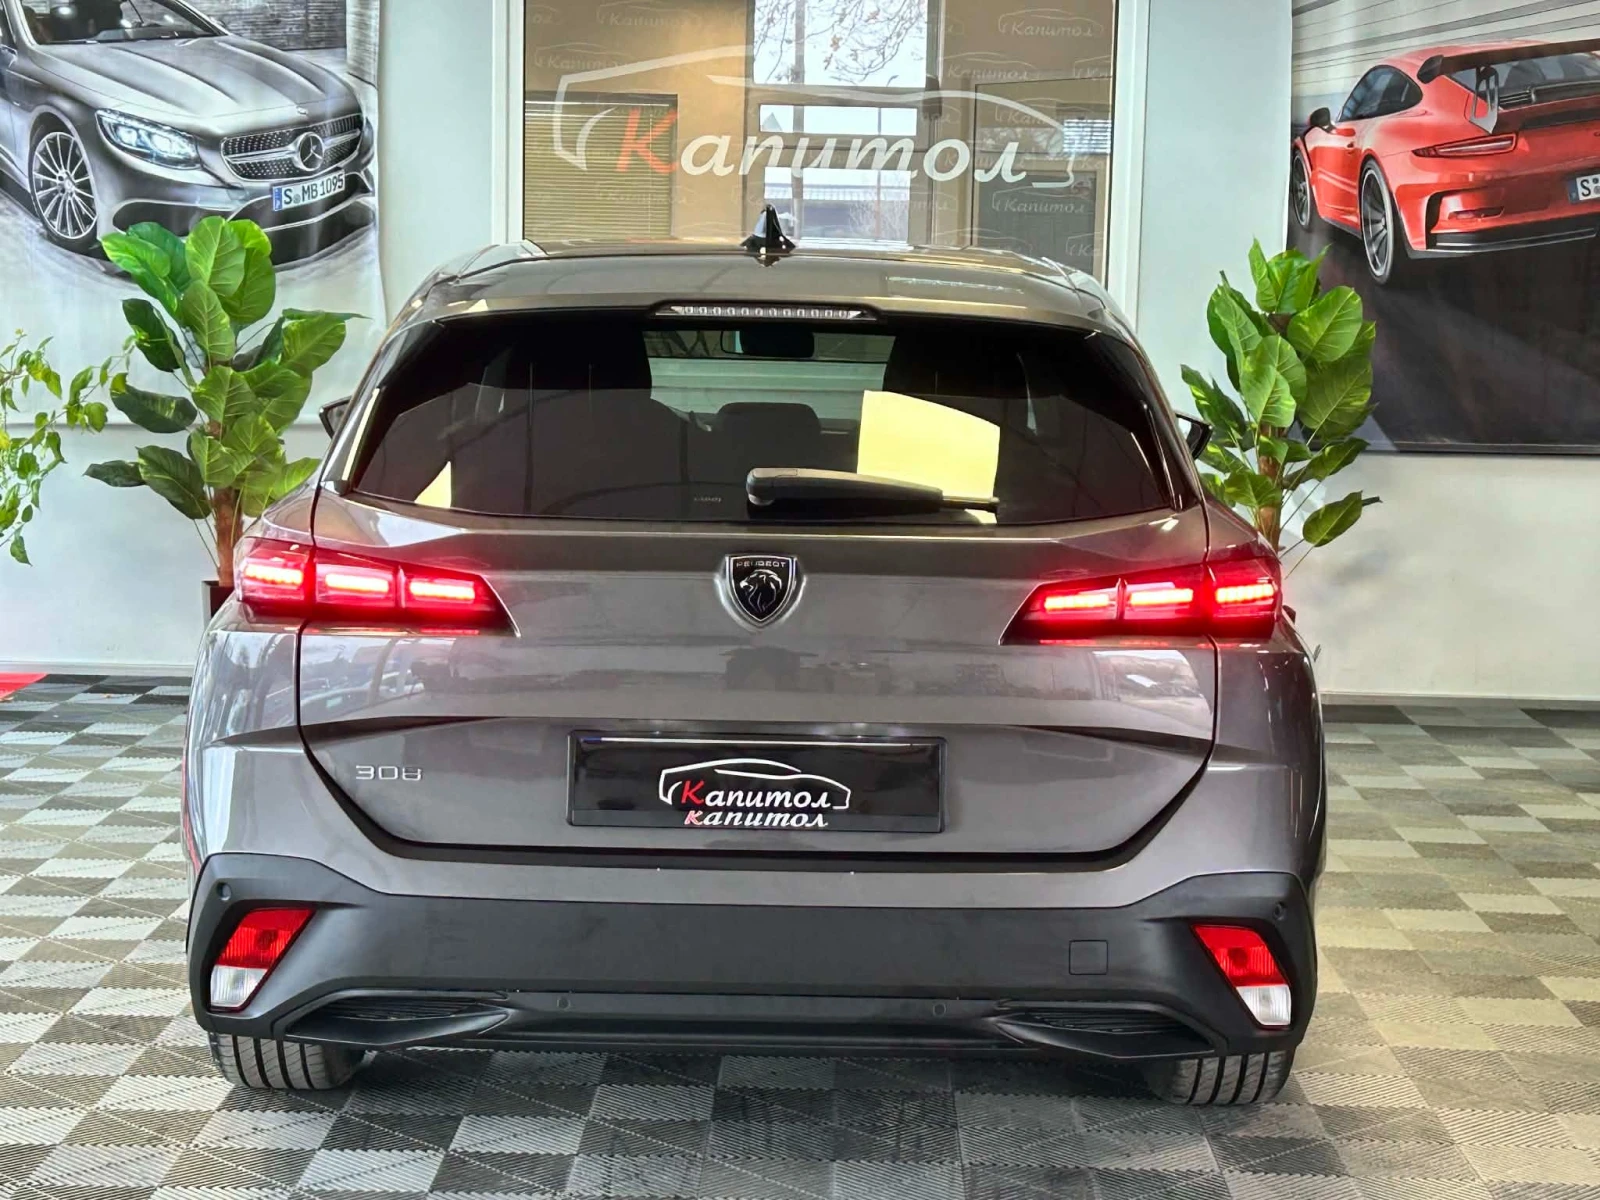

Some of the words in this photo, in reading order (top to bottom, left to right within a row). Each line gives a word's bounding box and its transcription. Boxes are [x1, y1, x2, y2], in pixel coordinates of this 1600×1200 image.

[616, 107, 1027, 182] Капитол
[283, 188, 293, 205] S
[355, 765, 423, 781] 308
[681, 780, 831, 808] Капитол
